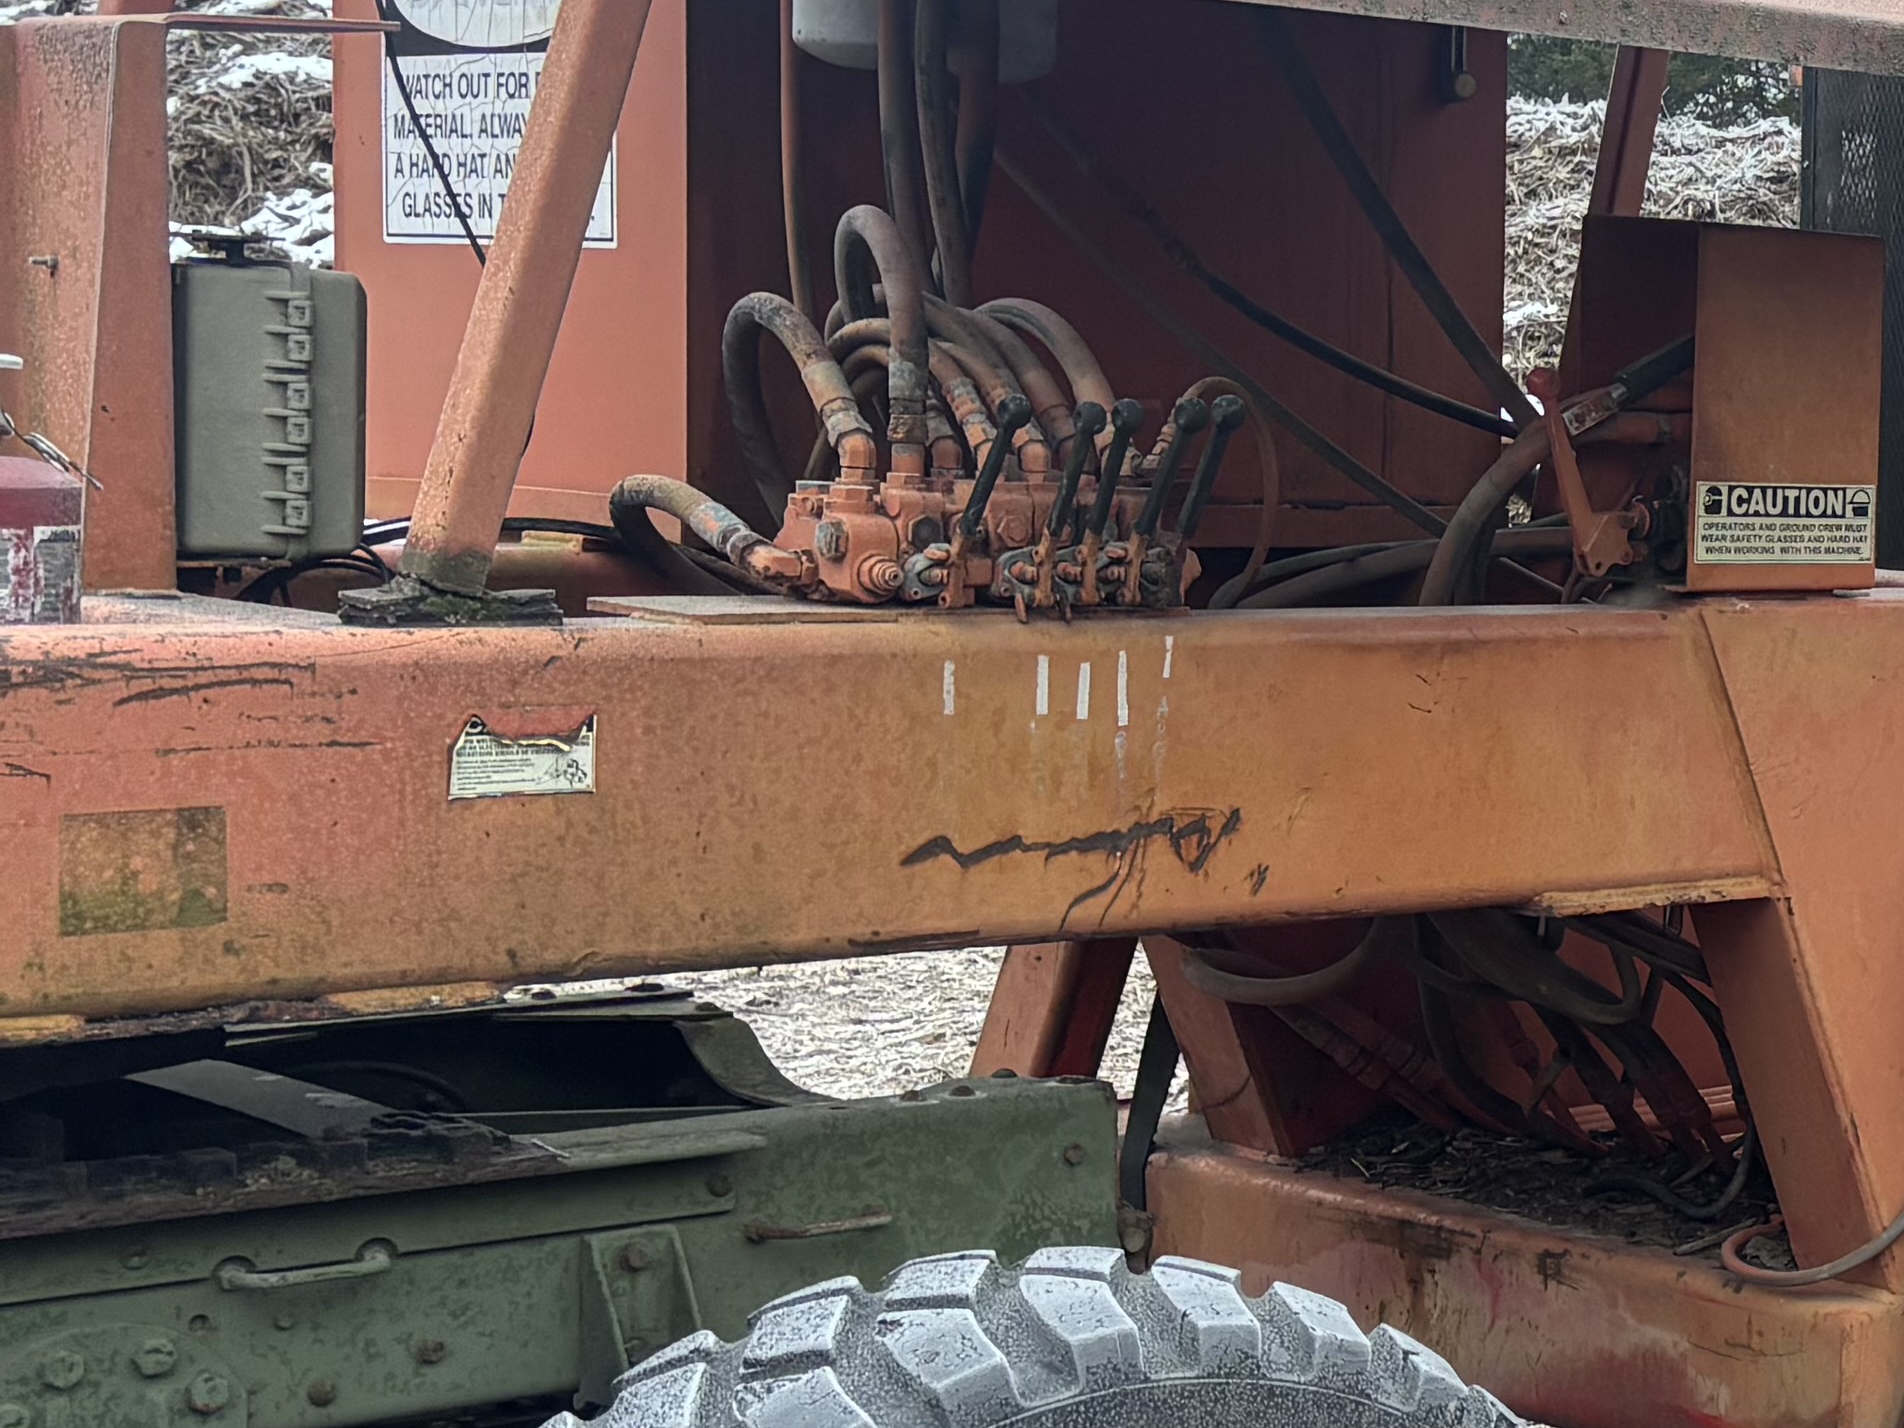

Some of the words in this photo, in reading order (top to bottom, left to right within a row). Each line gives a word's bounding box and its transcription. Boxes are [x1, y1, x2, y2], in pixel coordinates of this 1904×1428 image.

[458, 72, 491, 99] OUT
[496, 72, 531, 99] FOR
[394, 153, 405, 179] A
[410, 153, 452, 179] HAD
[457, 153, 487, 179] HAT
[493, 153, 516, 179] AN
[478, 193, 493, 219] IN
[1730, 487, 1844, 516] CAUTION
[1701, 534, 1728, 543] WEAR
[1729, 534, 1763, 543] SAFETY
[1765, 534, 1805, 544] GLASSES
[1807, 535, 1825, 544] AND
[1827, 535, 1851, 544] HARD
[1852, 535, 1868, 544] HAT
[1703, 522, 1756, 532] OPERATORS
[1759, 523, 1777, 532] AND
[1779, 523, 1816, 532] GROUND
[1817, 524, 1843, 532] CREW
[1844, 524, 1868, 532] MUST
[1705, 546, 1732, 555] WHEN
[1733, 546, 1775, 555] WORKING
[1780, 546, 1802, 555] WITH
[1803, 546, 1822, 555] THIS
